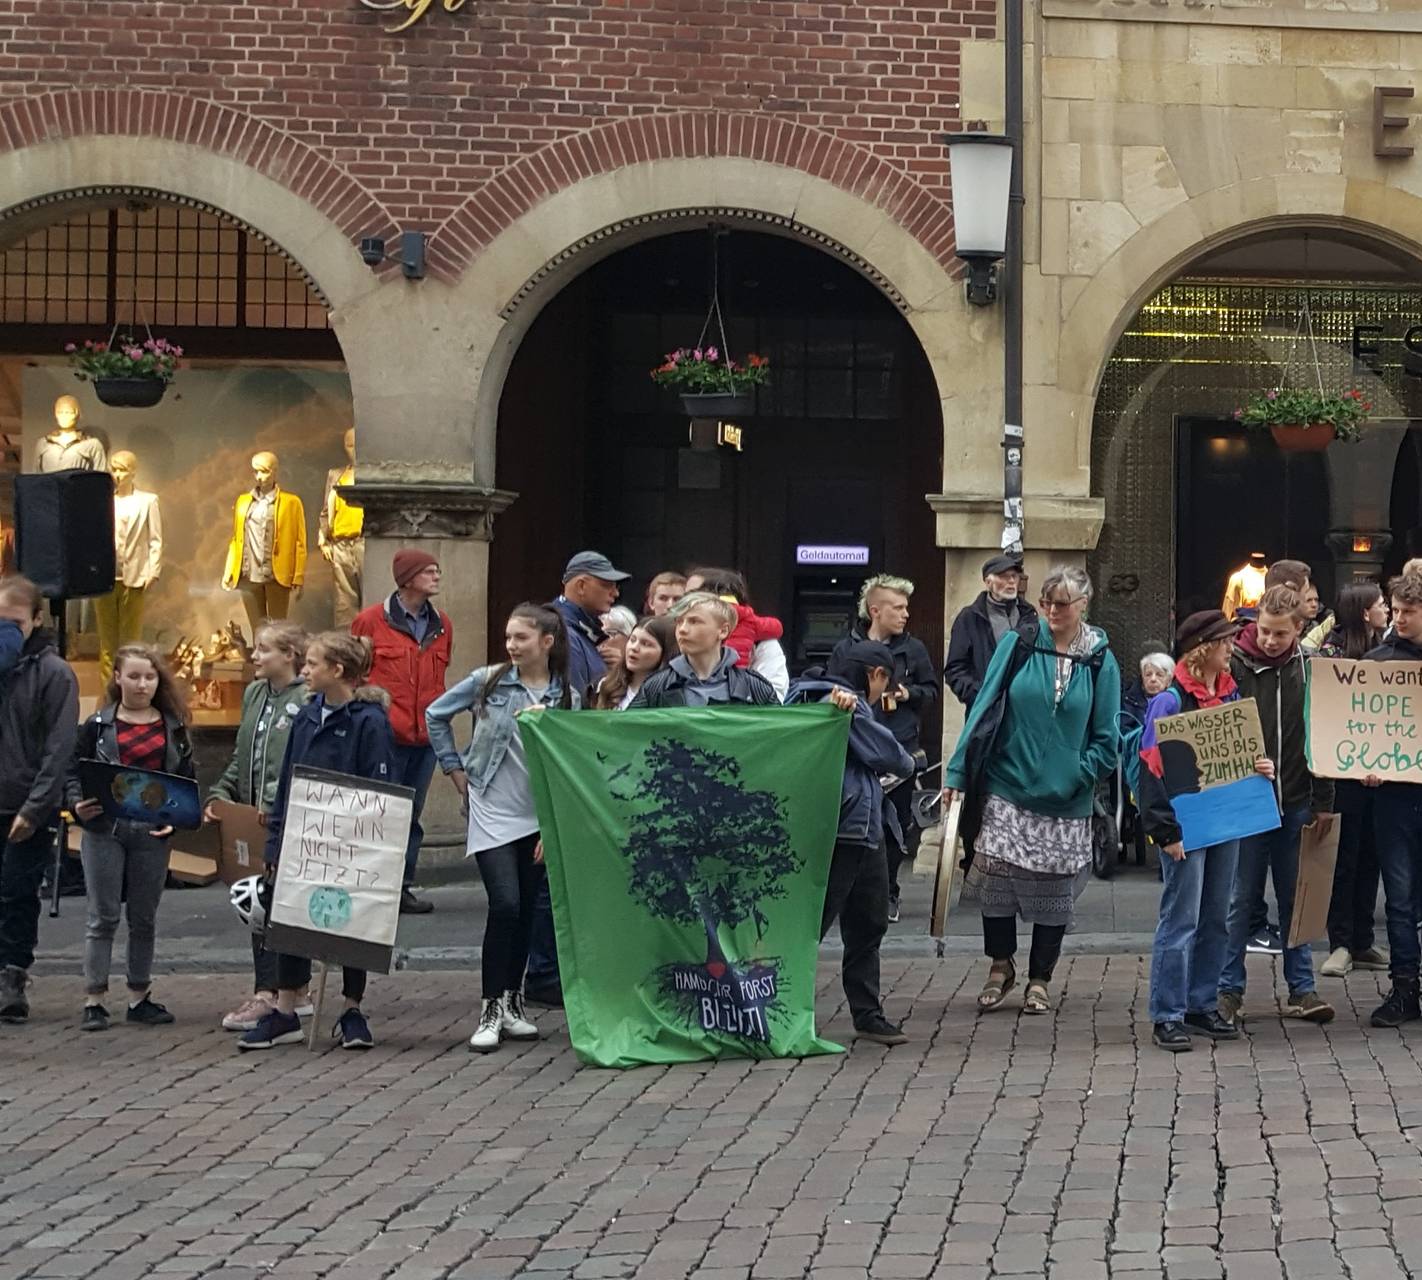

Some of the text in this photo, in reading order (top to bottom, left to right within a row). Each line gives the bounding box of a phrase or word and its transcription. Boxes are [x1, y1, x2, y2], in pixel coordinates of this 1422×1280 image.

[800, 548, 866, 561] Geldautomat
[1332, 663, 1368, 686] We
[1351, 691, 1415, 718] HOPE
[1158, 707, 1248, 735] DAS WASSER
[1345, 718, 1418, 739] for the
[1194, 723, 1244, 747] STEHT
[1199, 736, 1258, 761] UNS BIS
[1202, 752, 1266, 785] ZUM HAL
[305, 781, 388, 817] WANN
[301, 808, 385, 841] WENN
[299, 837, 360, 862] NICHT
[296, 858, 381, 889] JETZT?
[738, 974, 776, 1001] FORST
